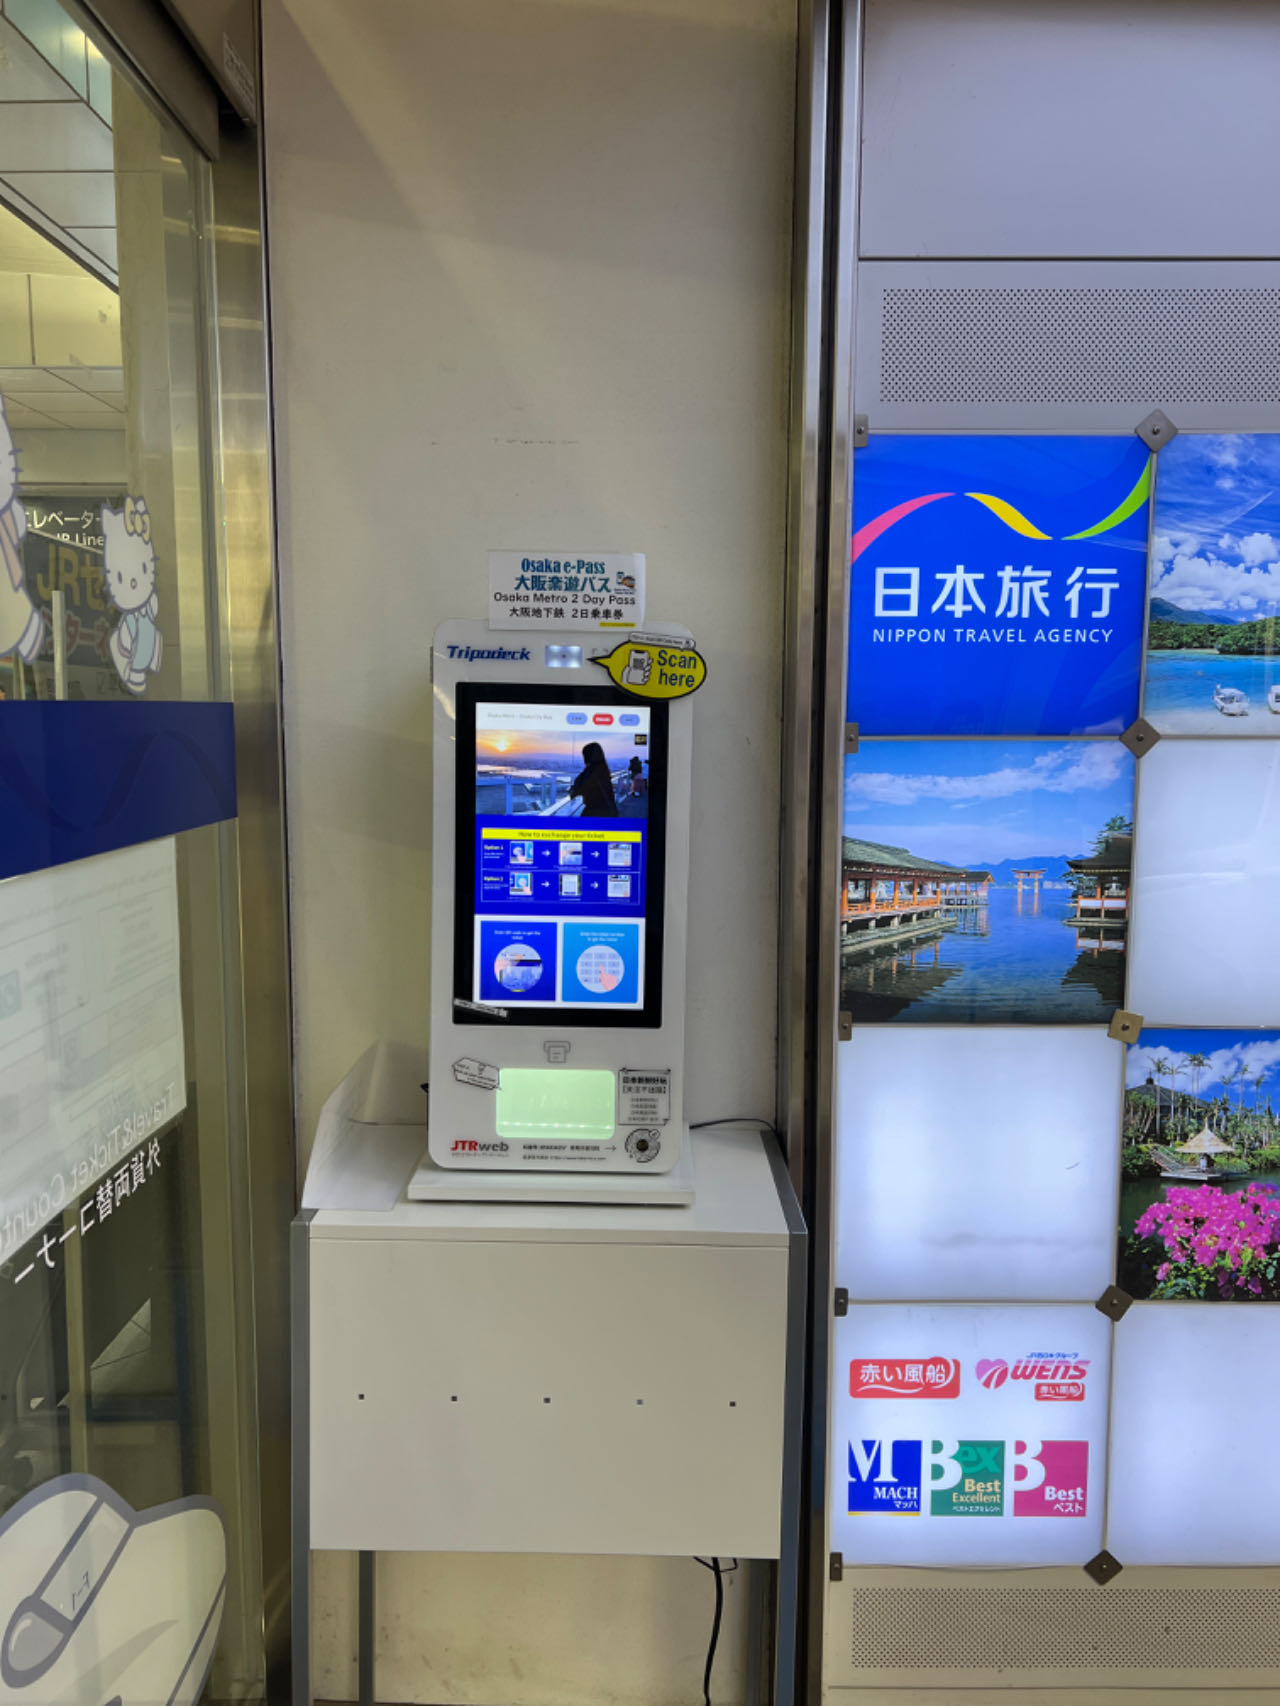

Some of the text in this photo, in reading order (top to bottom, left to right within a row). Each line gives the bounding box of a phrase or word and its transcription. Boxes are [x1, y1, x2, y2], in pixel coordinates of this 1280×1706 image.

[521, 558, 606, 575] Osaka e-Pass
[493, 591, 636, 606] Osaka Metro 2 Day Pass
[874, 564, 1120, 619] 日本旅行
[509, 607, 564, 618] 大阪地下鉄
[873, 629, 1113, 644] NIPPON TRAVEL AGENCY
[447, 645, 531, 662] Tripodeck
[657, 650, 697, 669] Scan
[658, 668, 696, 688] here
[451, 1140, 509, 1152] JTRweb
[860, 1363, 947, 1384] 赤い風船
[873, 1486, 918, 1500] MACH
[964, 1479, 1001, 1493] Best
[952, 1492, 1001, 1504] Excellent
[1044, 1486, 1084, 1502] Best
[893, 1501, 918, 1509] マッハ
[1053, 1502, 1083, 1514] ベスト
